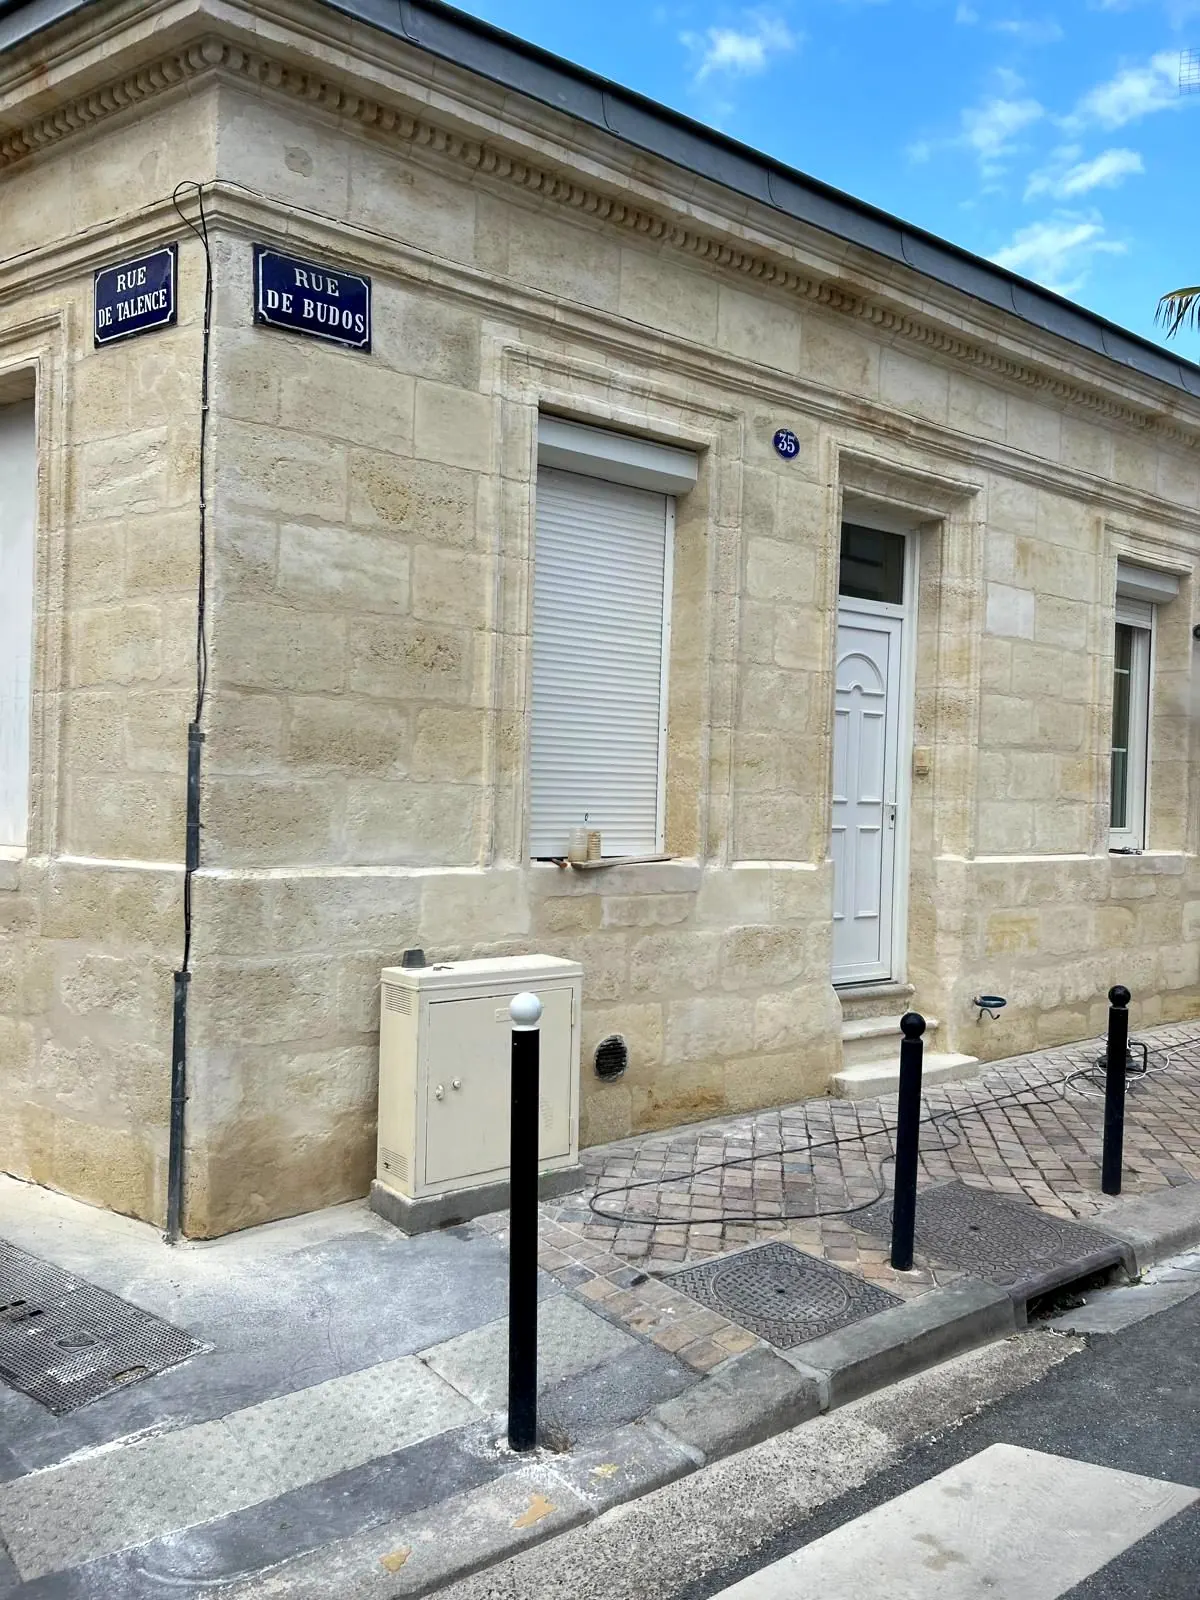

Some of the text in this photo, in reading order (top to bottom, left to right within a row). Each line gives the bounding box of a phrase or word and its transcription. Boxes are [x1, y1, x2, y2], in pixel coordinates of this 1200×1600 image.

[116, 266, 147, 292] RUE
[294, 268, 339, 296] RUE
[98, 289, 167, 328] DE TALENCE
[266, 290, 364, 333] DE BUDOS
[778, 432, 795, 453] 35
